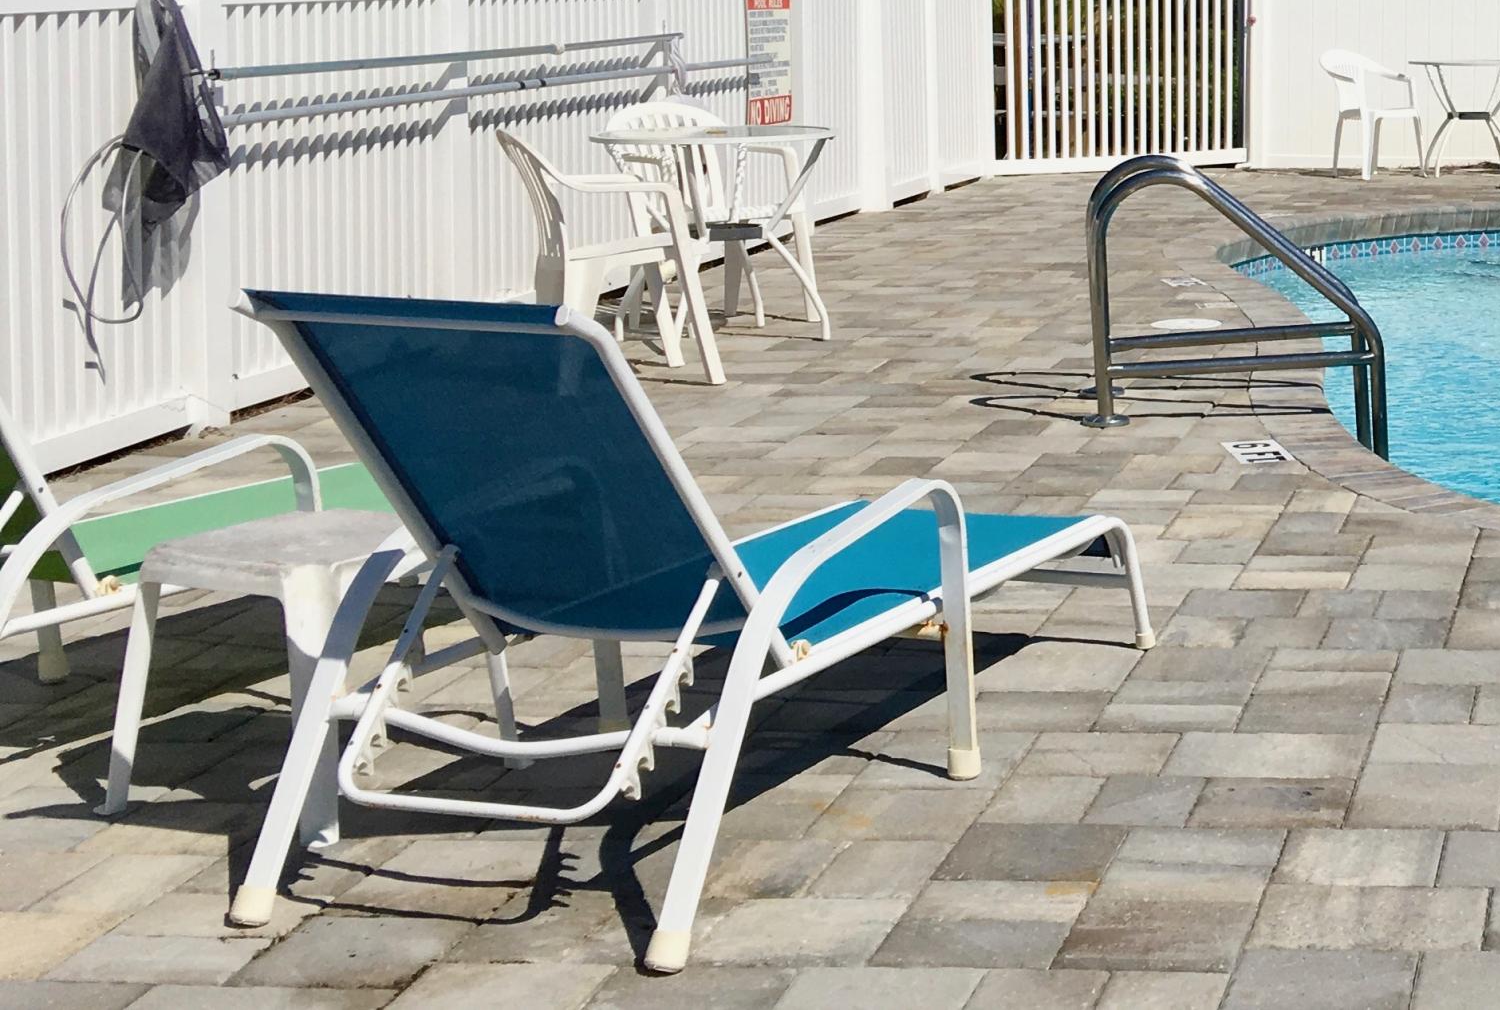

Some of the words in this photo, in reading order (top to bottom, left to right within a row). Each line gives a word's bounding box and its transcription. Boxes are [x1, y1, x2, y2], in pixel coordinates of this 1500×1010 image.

[751, 100, 762, 125] NO
[764, 96, 790, 123] DIVING
[1241, 451, 1287, 462] FT
